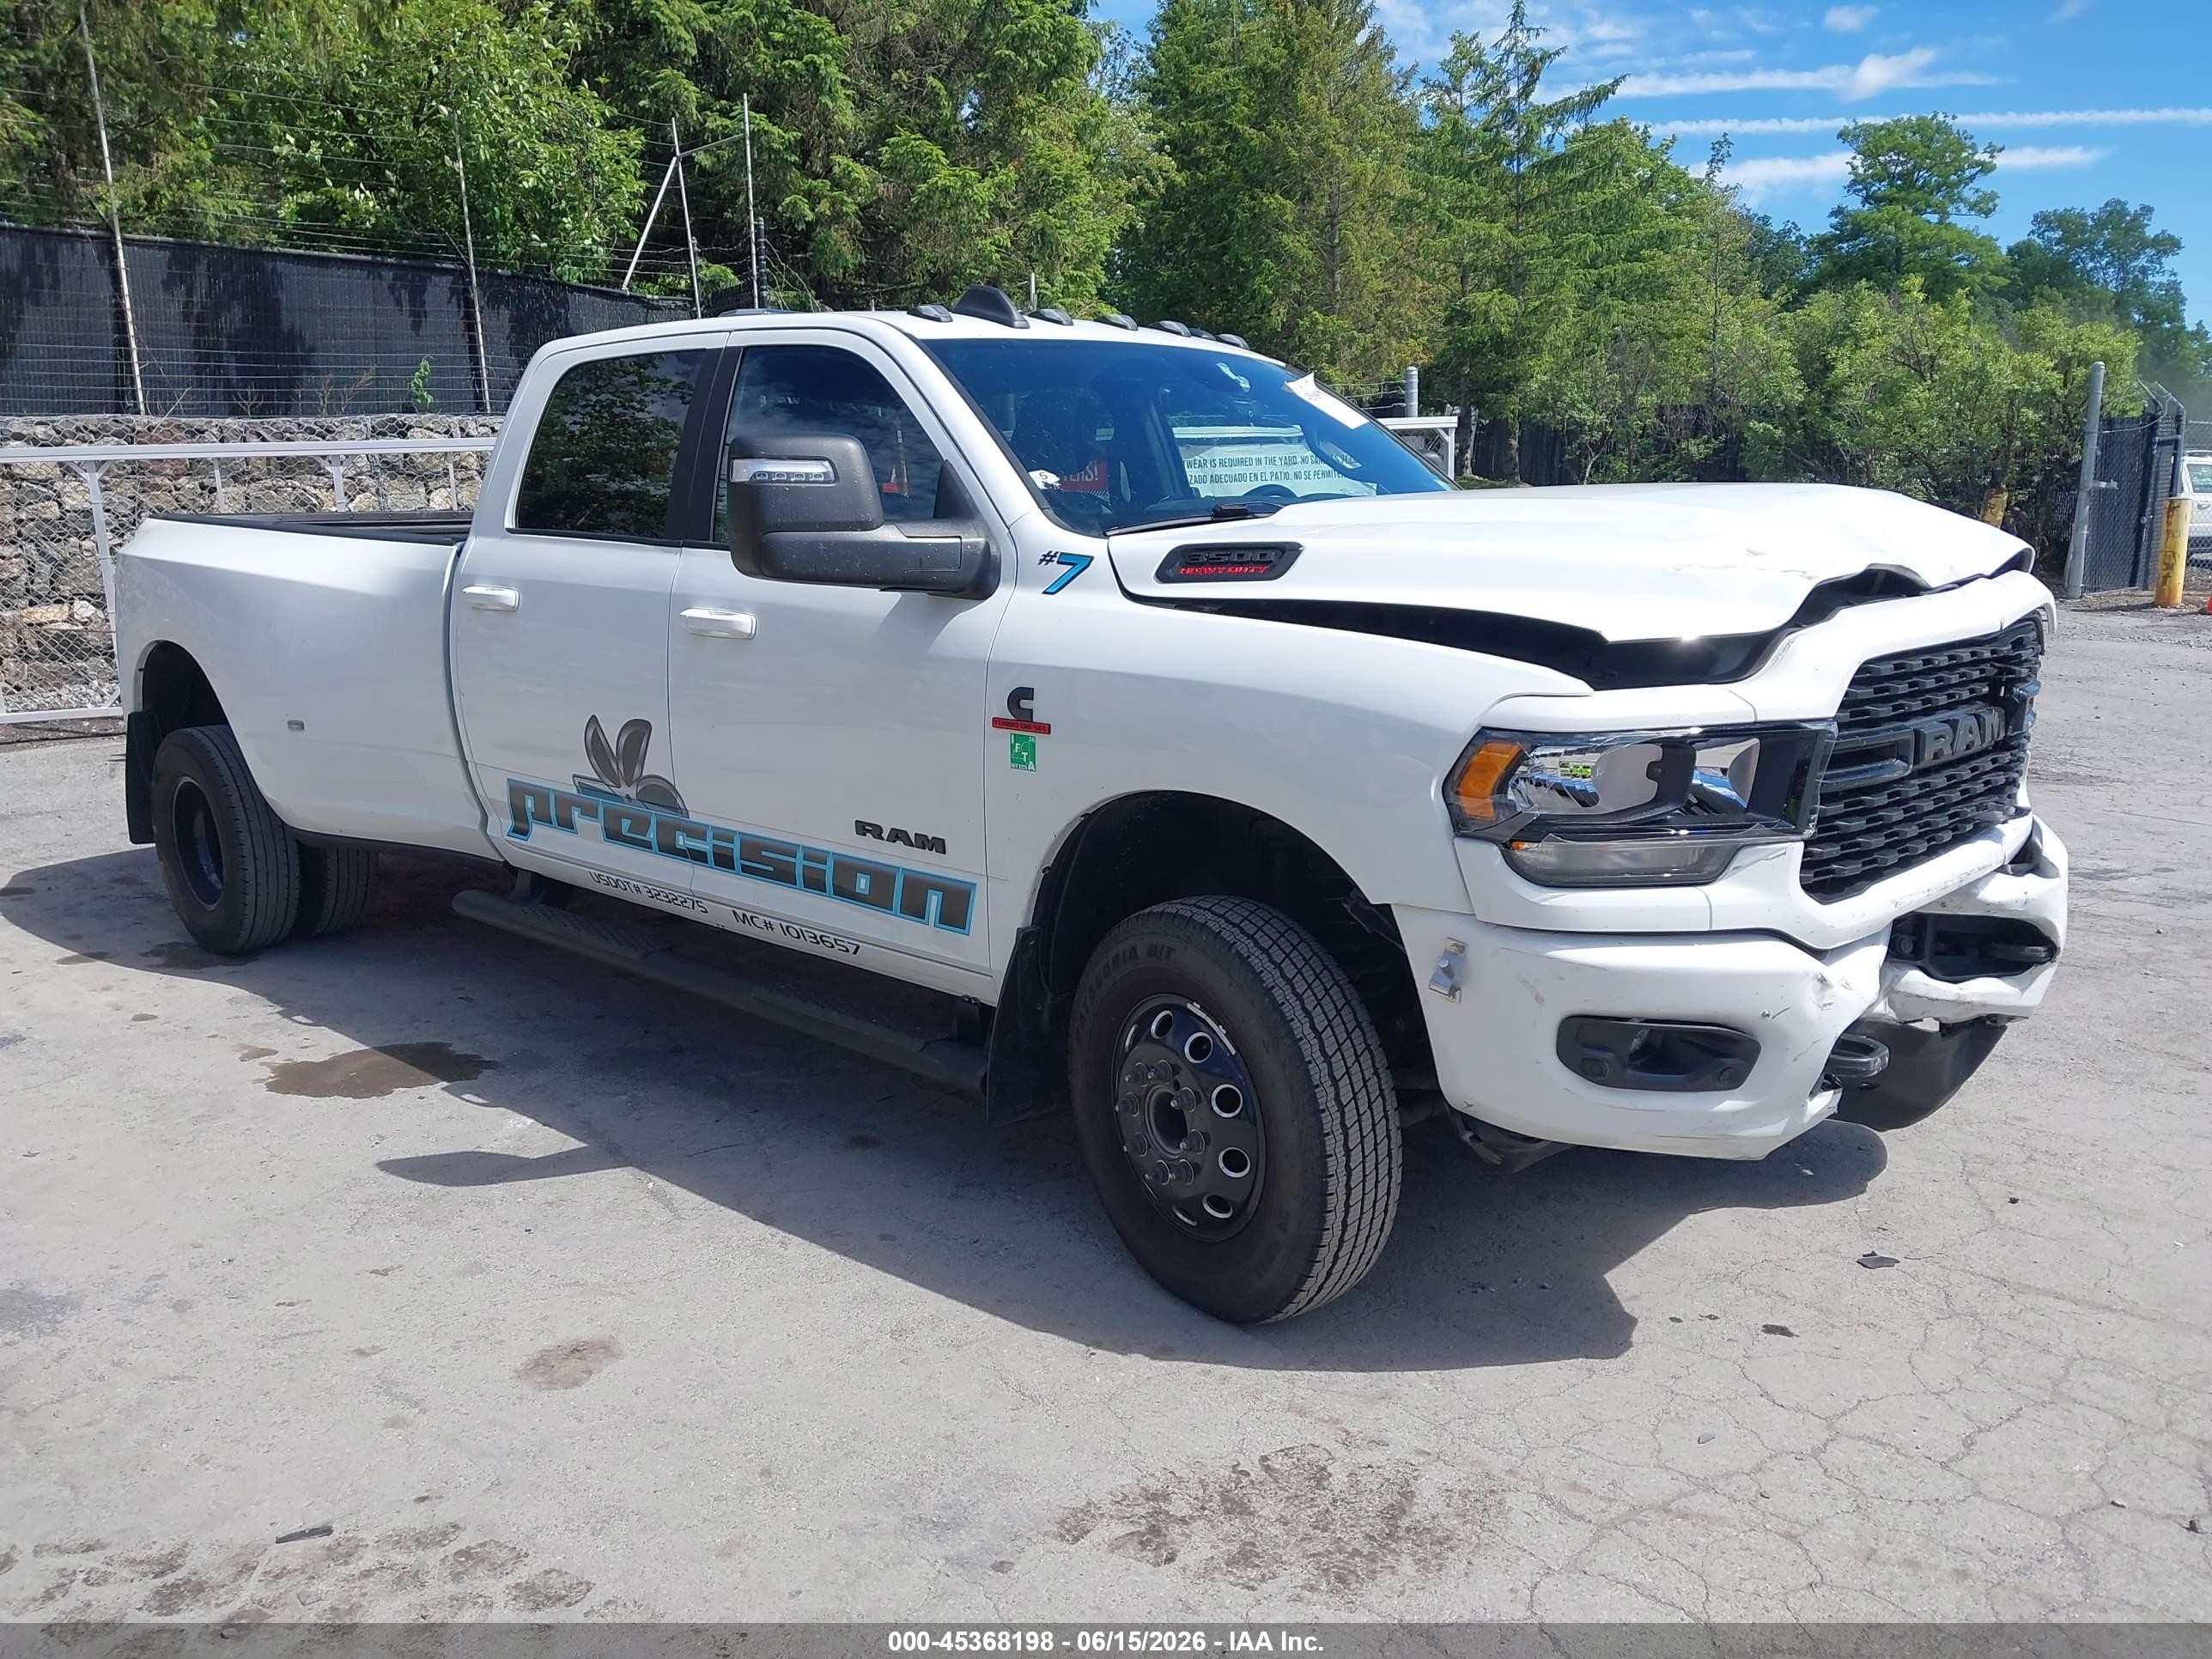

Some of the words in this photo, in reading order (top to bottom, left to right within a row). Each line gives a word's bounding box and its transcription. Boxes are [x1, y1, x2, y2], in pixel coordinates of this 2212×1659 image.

[1210, 458, 1218, 469] IS
[1218, 456, 1254, 468] REQUIRED
[1255, 456, 1262, 466] IN
[1264, 455, 1277, 466] THE
[1279, 455, 1298, 466] YARD.
[1301, 454, 1310, 465] NO
[1210, 472, 1247, 484] ADECUADO
[1249, 471, 1258, 482] EN
[1261, 471, 1268, 482] EL
[1294, 471, 1303, 480] NO
[1304, 470, 1312, 480] SE
[1187, 551, 1276, 563] 3500
[1925, 707, 2006, 762] RAM
[854, 819, 947, 855] RAM
[588, 870, 644, 896] USDOT#
[644, 885, 708, 915] 3232275
[732, 908, 775, 933] MC#
[779, 922, 861, 957] 1013657
